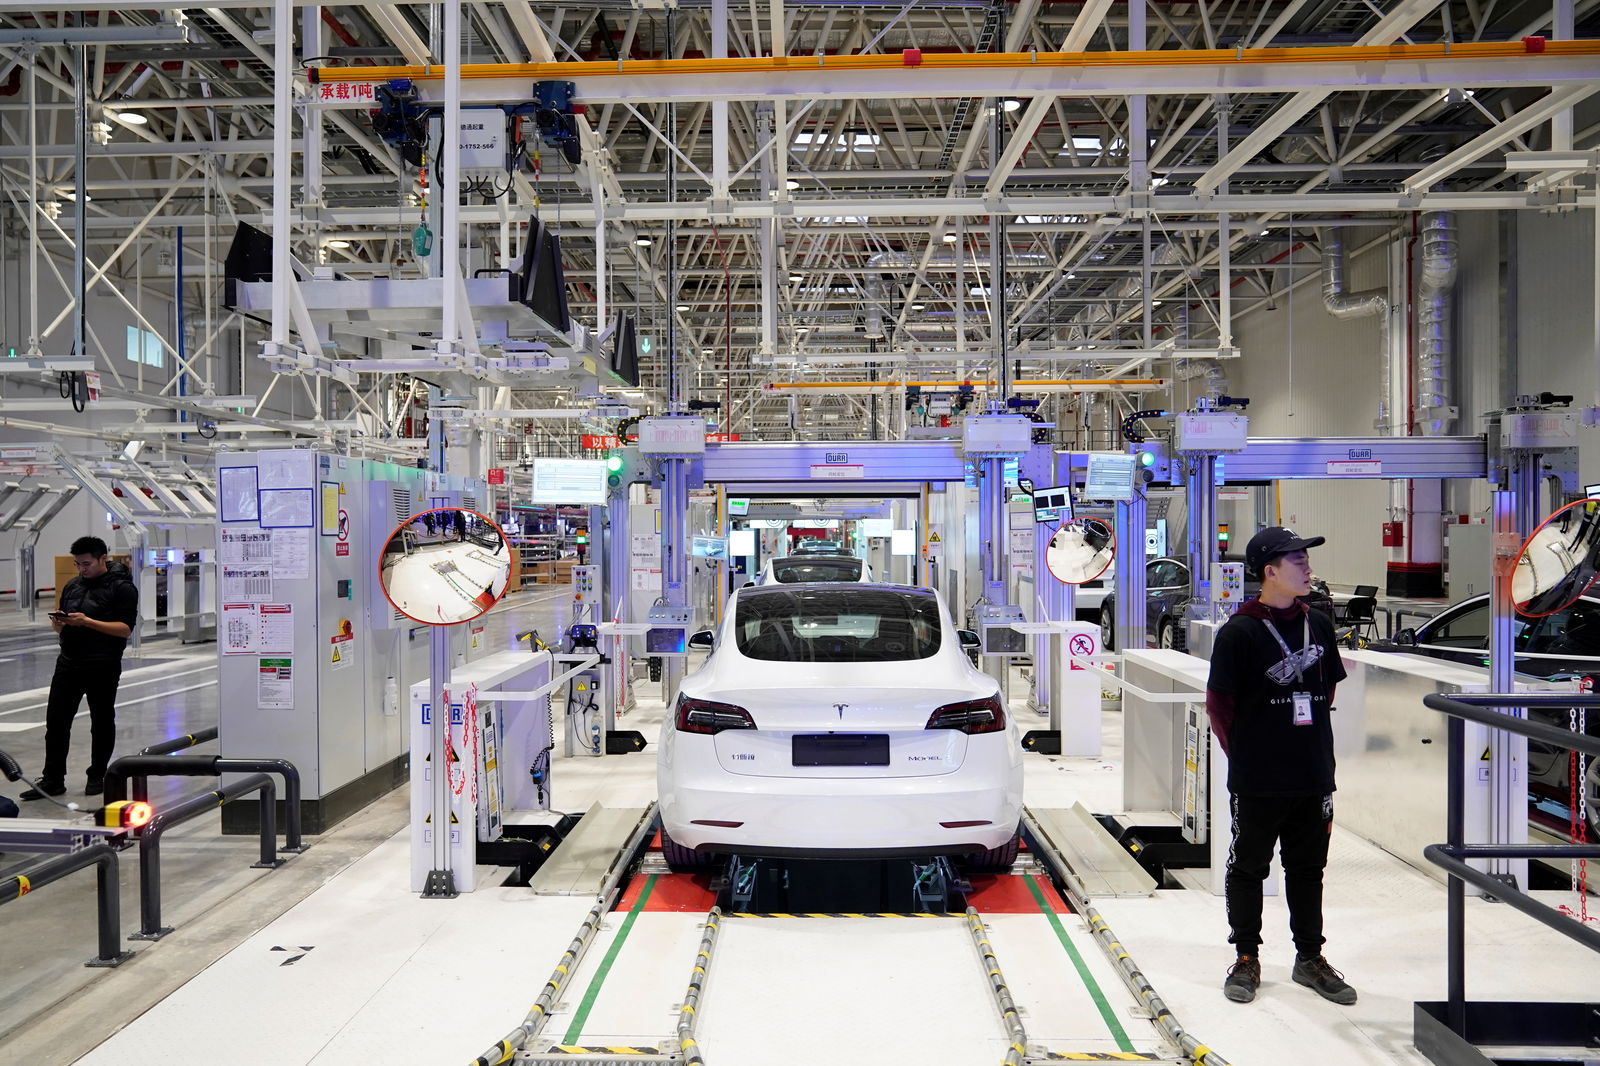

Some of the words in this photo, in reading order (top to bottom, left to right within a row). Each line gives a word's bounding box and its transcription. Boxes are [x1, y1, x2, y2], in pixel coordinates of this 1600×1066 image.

[320, 82, 373, 100] 承载1吨
[424, 706, 462, 722] DR
